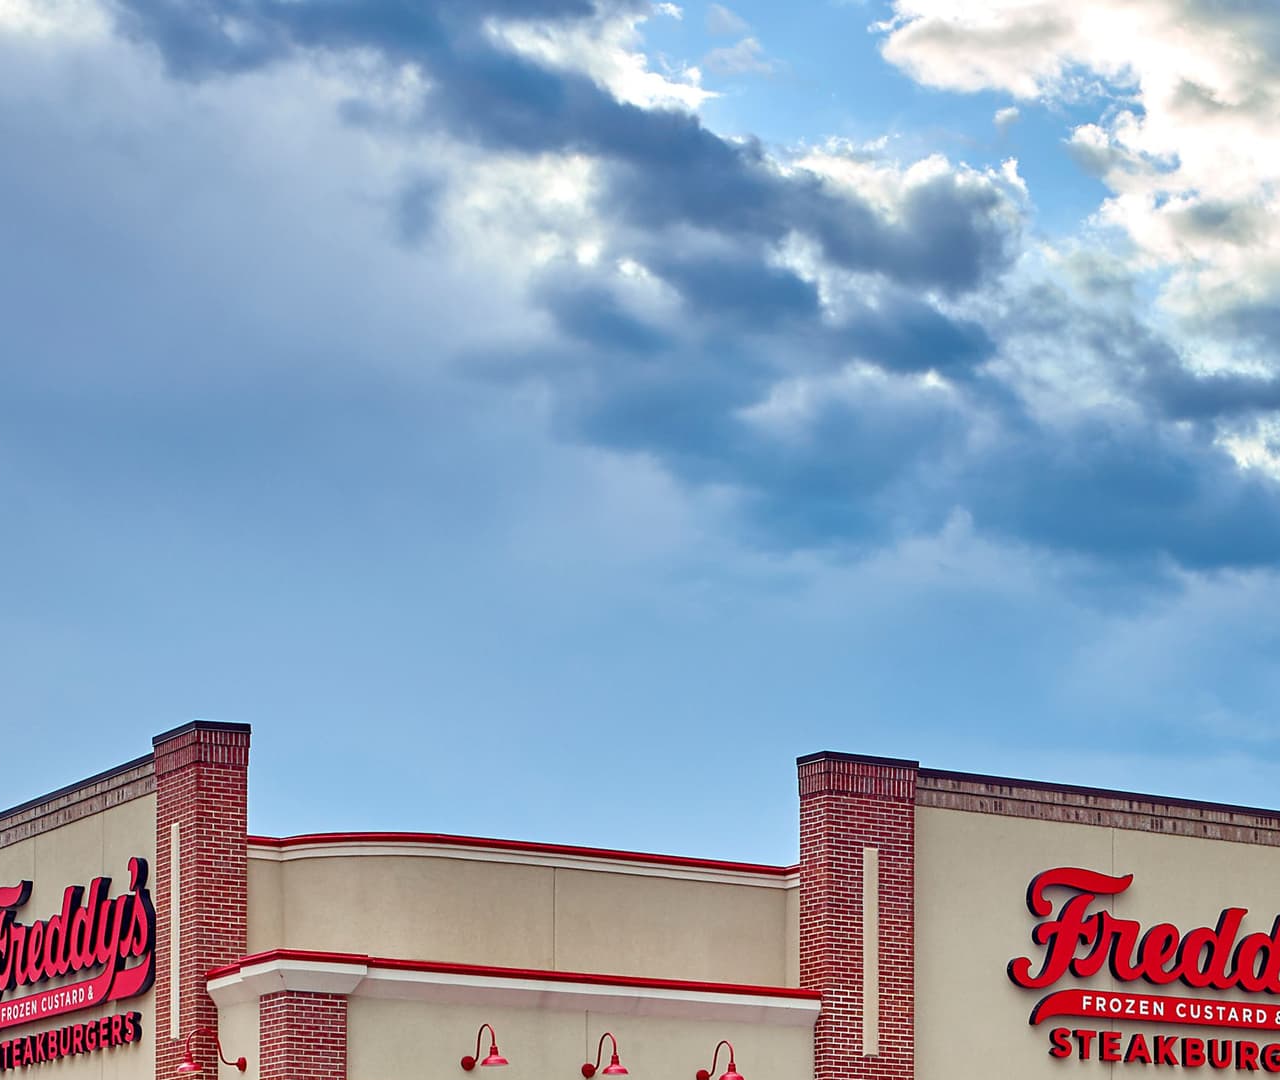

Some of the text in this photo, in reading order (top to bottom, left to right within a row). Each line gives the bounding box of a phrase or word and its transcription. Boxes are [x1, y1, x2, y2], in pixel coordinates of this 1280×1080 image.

[1, 985, 94, 1022] FROZEN CUSTARD &
[1082, 995, 1165, 1017] FROZEN
[1176, 1003, 1267, 1024] CUSTARD
